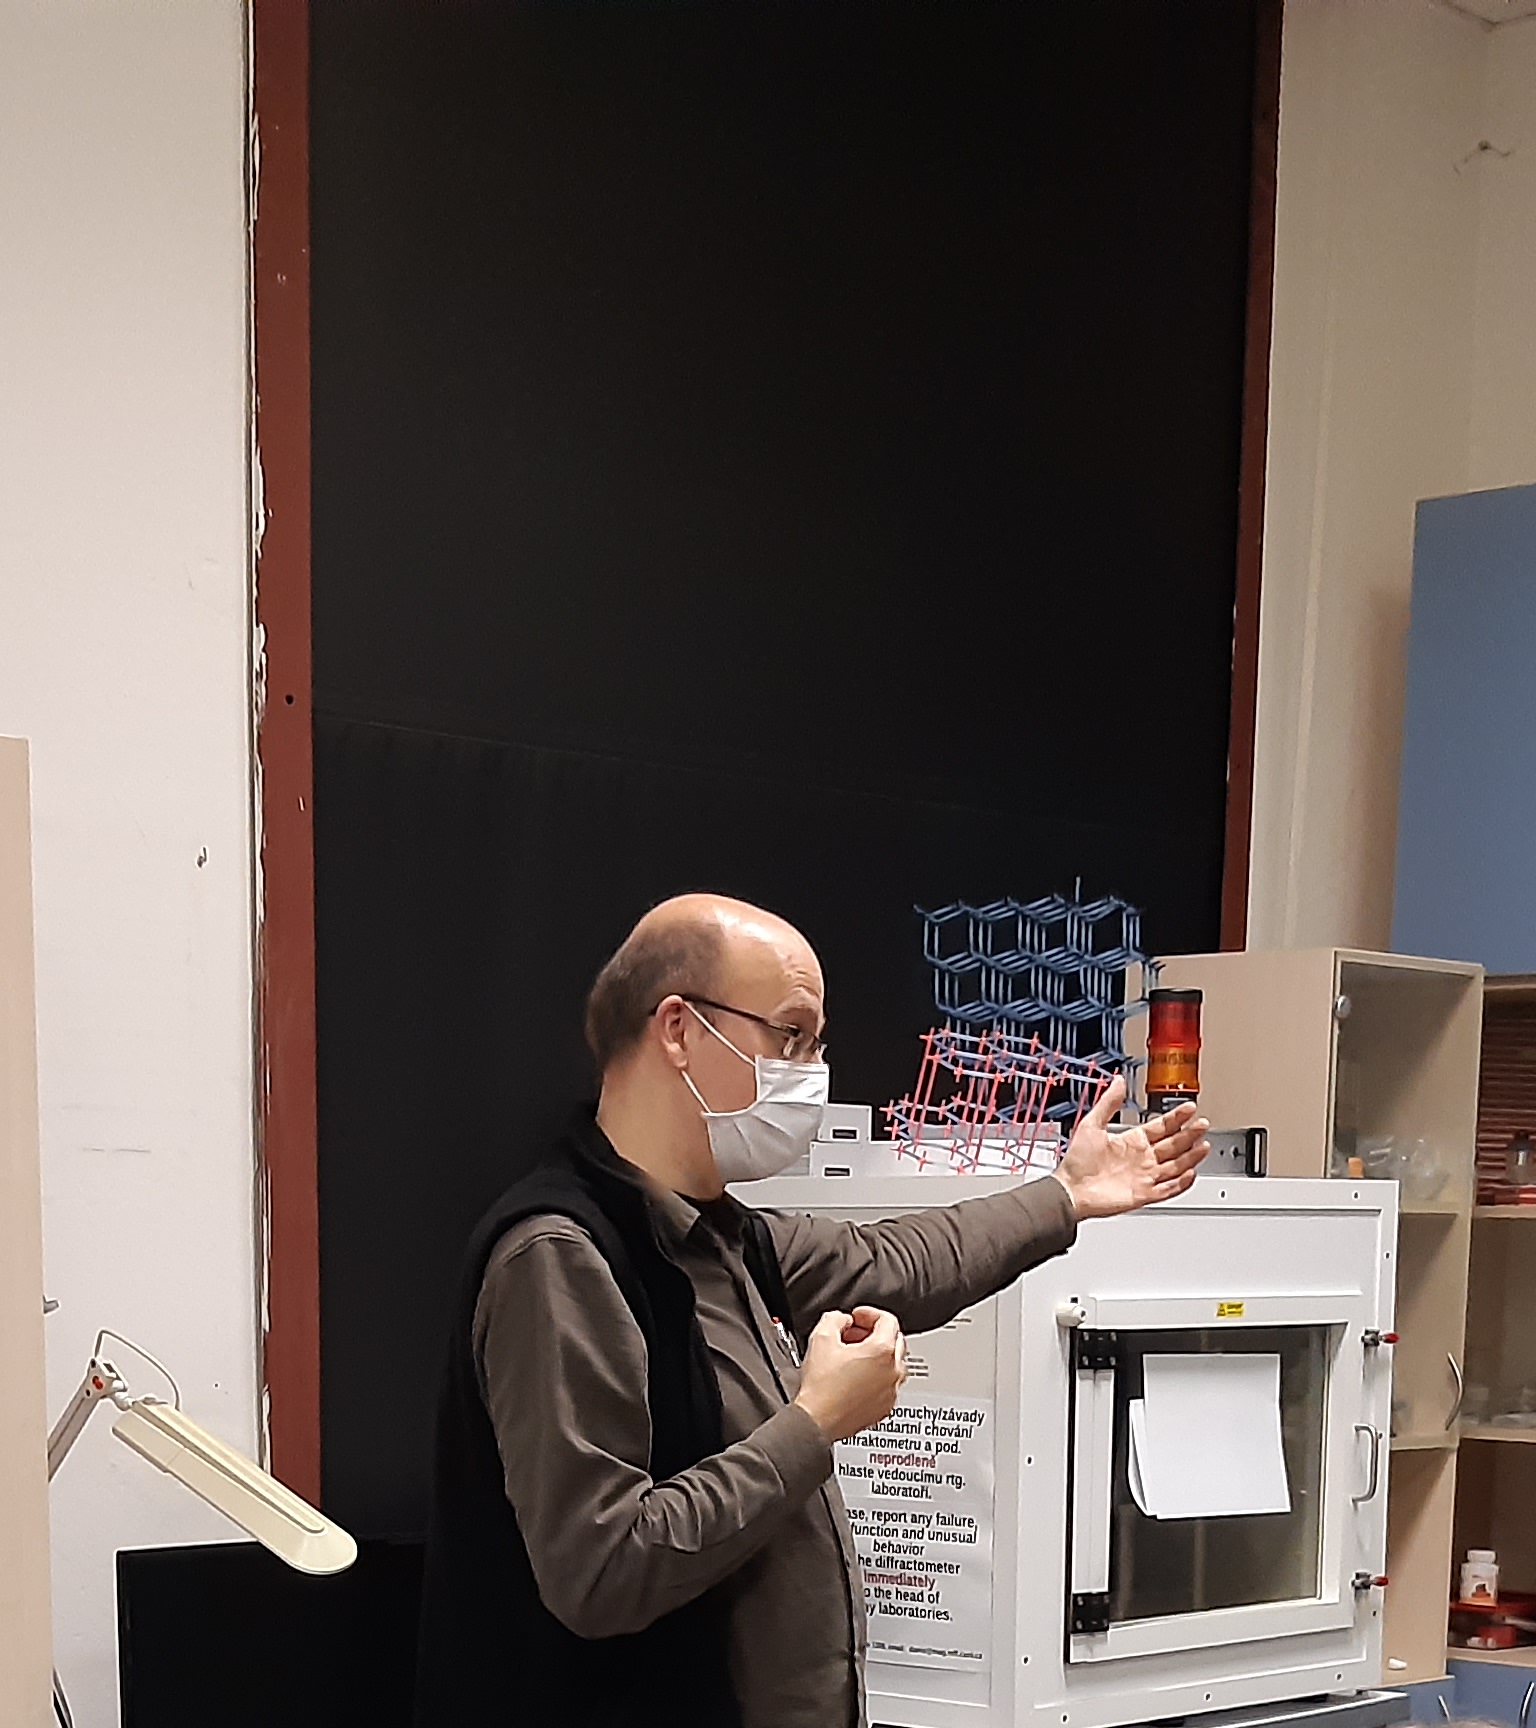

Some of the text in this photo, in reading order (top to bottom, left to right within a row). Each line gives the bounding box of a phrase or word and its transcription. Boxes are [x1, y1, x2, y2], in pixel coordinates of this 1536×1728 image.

[924, 1440, 932, 1451] a
[935, 1440, 962, 1455] pod.
[877, 1467, 943, 1484] vedoucímu
[871, 1510, 907, 1526] report
[910, 1512, 933, 1529] any
[936, 1512, 977, 1529] failure,
[851, 1522, 977, 1544] function and unusual
[872, 1539, 925, 1556] behavior
[875, 1555, 960, 1574] diffractometer
[874, 1586, 892, 1600] the
[895, 1587, 924, 1603] head
[927, 1591, 940, 1605] of
[878, 1601, 953, 1621] laboratories.
